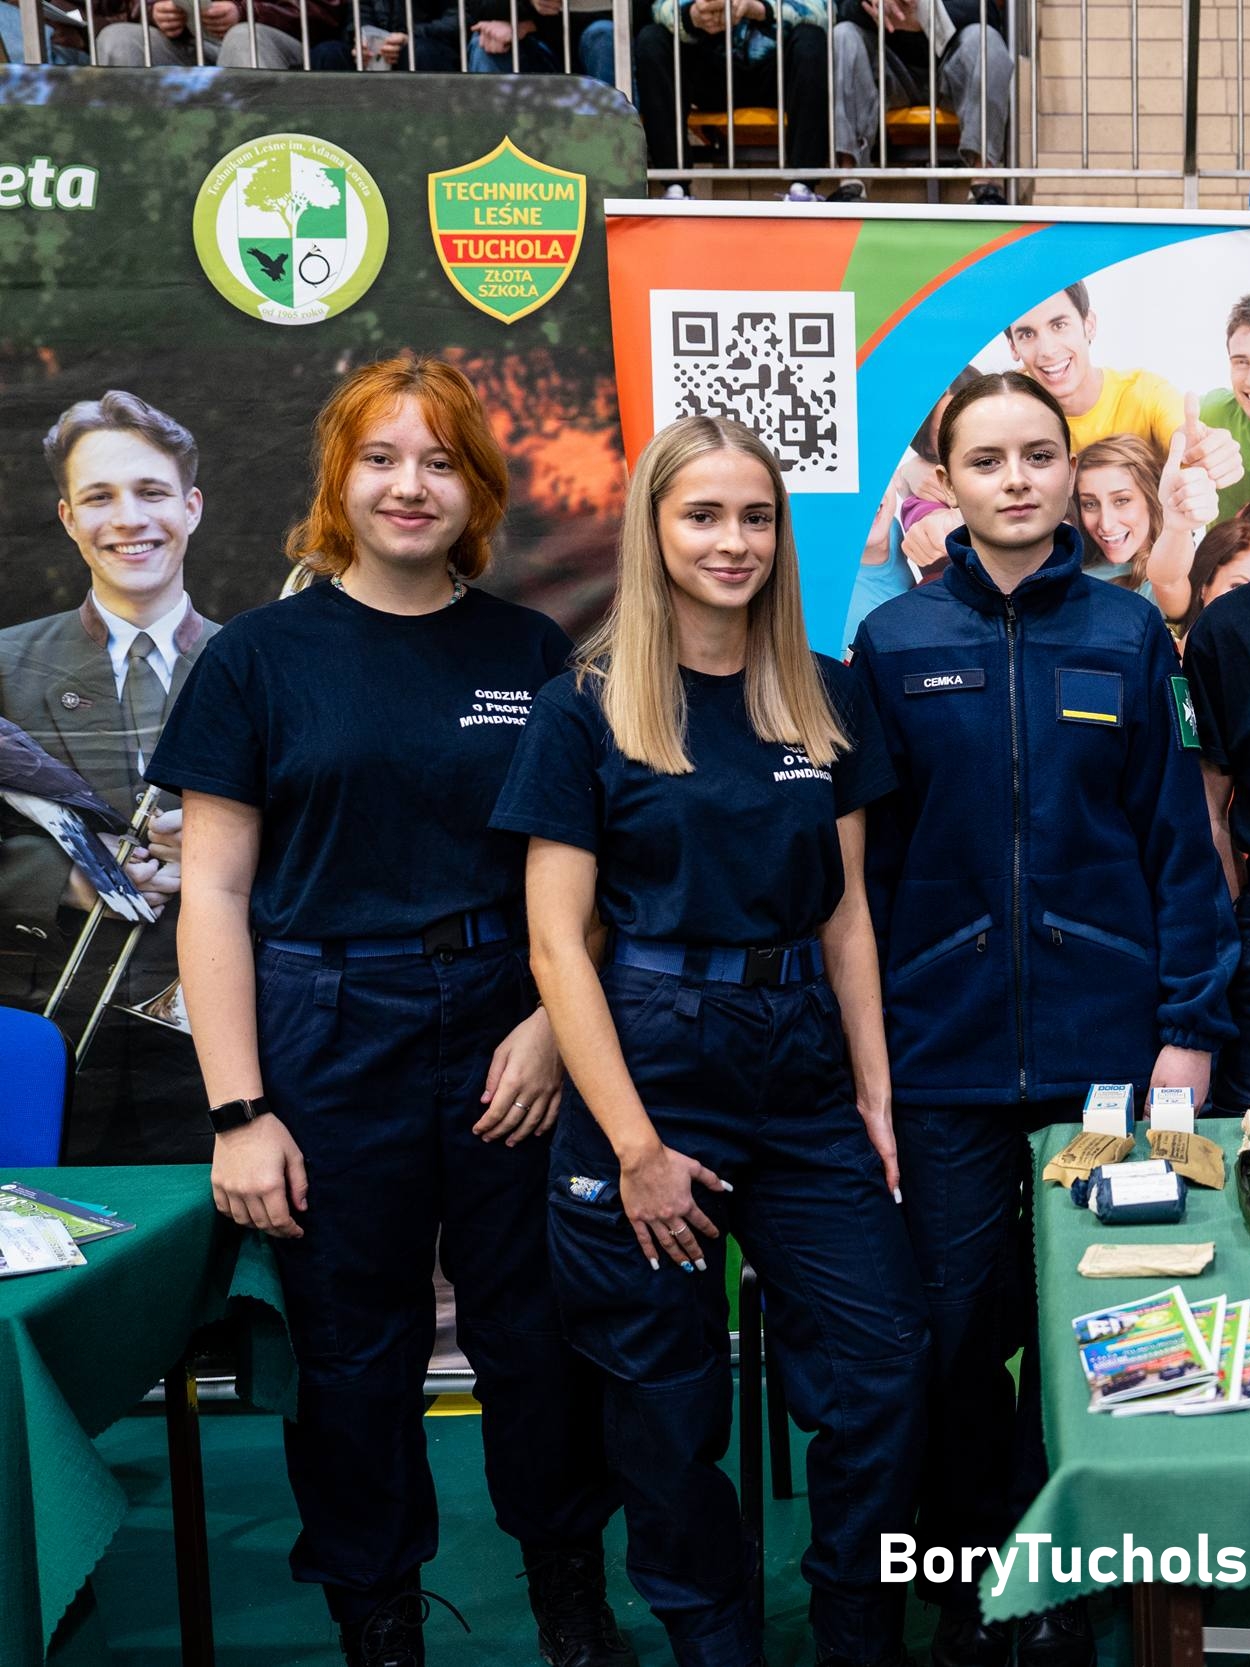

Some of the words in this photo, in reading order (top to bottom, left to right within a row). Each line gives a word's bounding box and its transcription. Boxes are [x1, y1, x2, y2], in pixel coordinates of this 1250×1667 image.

[207, 151, 254, 196] Technikum
[253, 141, 286, 156] Leśne
[289, 140, 306, 151] im.
[311, 144, 345, 169] Adama
[345, 164, 372, 197] Loreta
[0, 157, 97, 209] eta
[441, 182, 575, 201] TECHNIKUM
[474, 202, 543, 226] LEŚNE
[452, 239, 564, 260] TUCHOLA
[484, 269, 533, 283] ZŁOTA
[478, 284, 539, 298] SZKOŁA
[262, 308, 275, 317] od
[277, 309, 299, 319] 1965
[301, 309, 324, 319] roku
[923, 675, 963, 688] CEMKA
[475, 689, 532, 701] ODDZIAŁ
[472, 703, 483, 712] O
[486, 702, 532, 714] PROFIL
[459, 714, 527, 728] MUNDURO
[783, 755, 795, 765] O
[773, 768, 833, 782] MUNDURO
